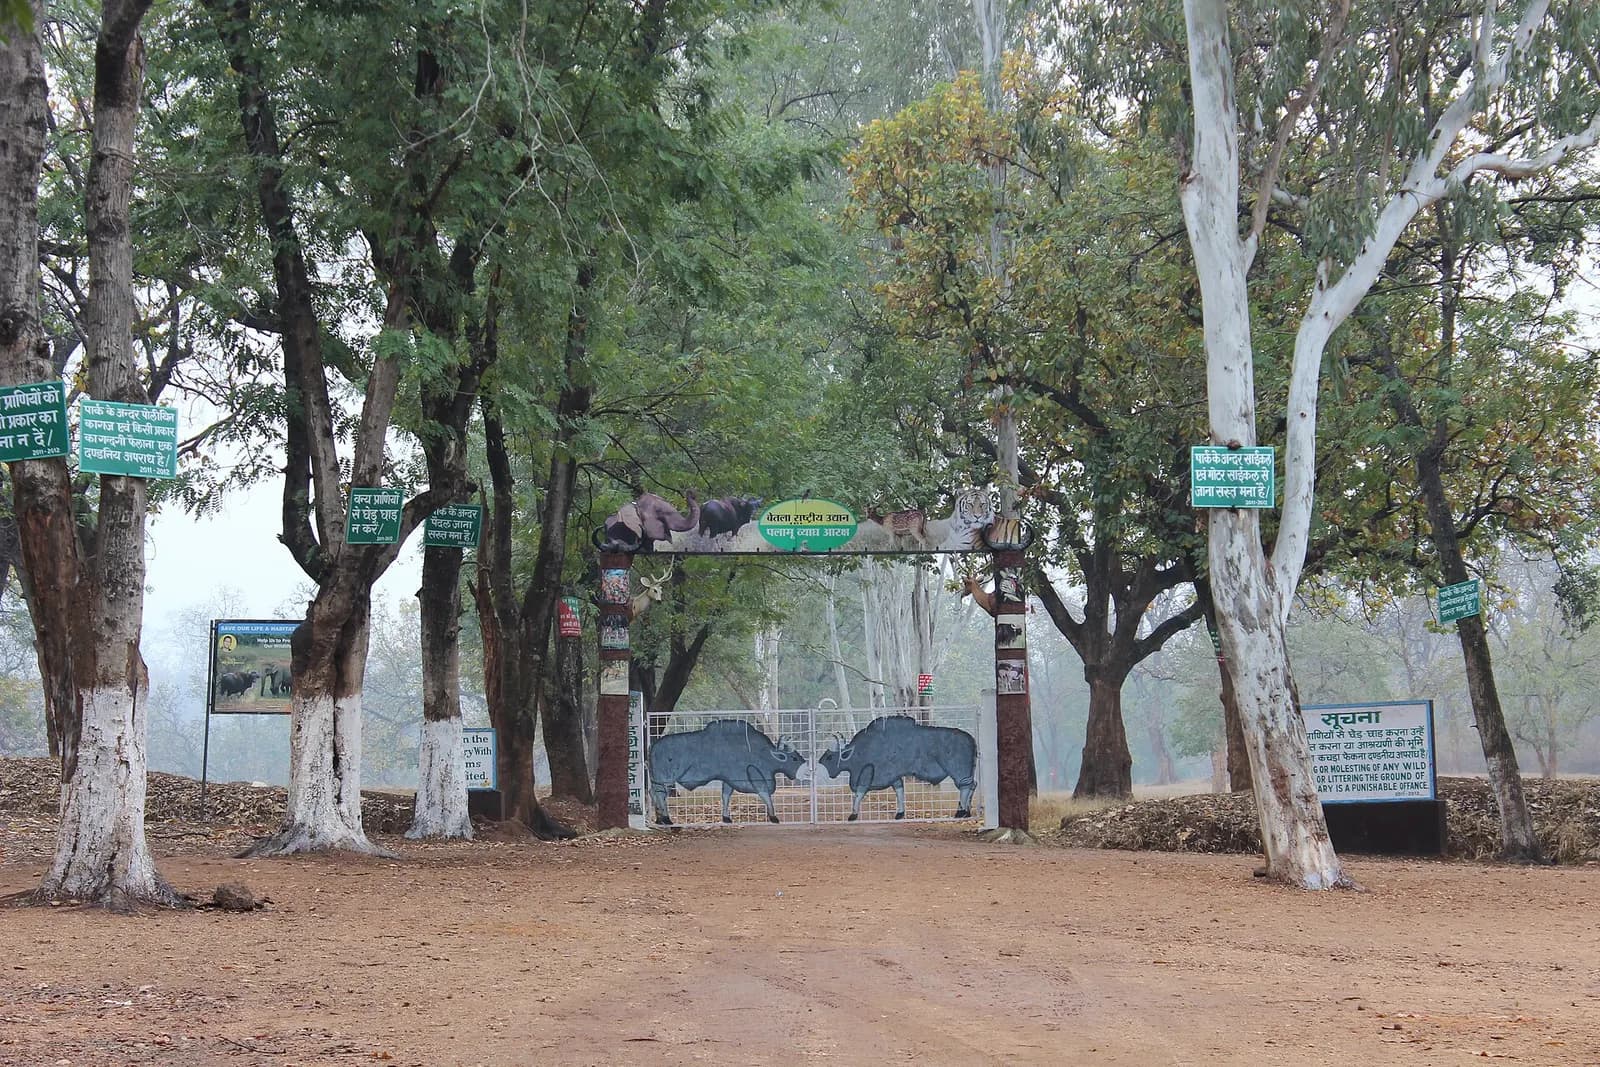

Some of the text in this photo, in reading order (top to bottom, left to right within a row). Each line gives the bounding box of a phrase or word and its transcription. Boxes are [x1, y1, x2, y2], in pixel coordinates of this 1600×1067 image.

[43, 385, 60, 404] को
[83, 403, 104, 416] पार्क
[105, 405, 115, 417] के
[116, 408, 141, 420] अन्दर
[7, 412, 38, 429] प्रकार
[38, 410, 58, 424] का
[132, 422, 153, 435] किसी
[16, 433, 29, 447] न
[1195, 486, 1215, 497] जाना
[1238, 486, 1257, 497] मना
[353, 494, 372, 504] वन्य
[352, 506, 361, 520] से
[352, 523, 361, 534] न
[1320, 711, 1382, 730] सूचना
[472, 735, 489, 743] the
[1336, 729, 1345, 739] से
[1385, 727, 1408, 737] करना
[473, 747, 492, 755] With
[1318, 742, 1341, 751] करना
[1344, 741, 1355, 750] या
[1319, 765, 1329, 774] OR
[1330, 763, 1371, 773] MOLESTING
[1372, 763, 1381, 772] OF
[1382, 762, 1400, 771] ANY
[1403, 761, 1427, 771] WILD
[1316, 771, 1425, 784] OR LITTERING THE GROUND OF
[1335, 784, 1343, 793] IS
[1345, 783, 1351, 792] A
[1351, 782, 1397, 792] PUNISHABLE
[1399, 781, 1428, 791] OFFANCE
